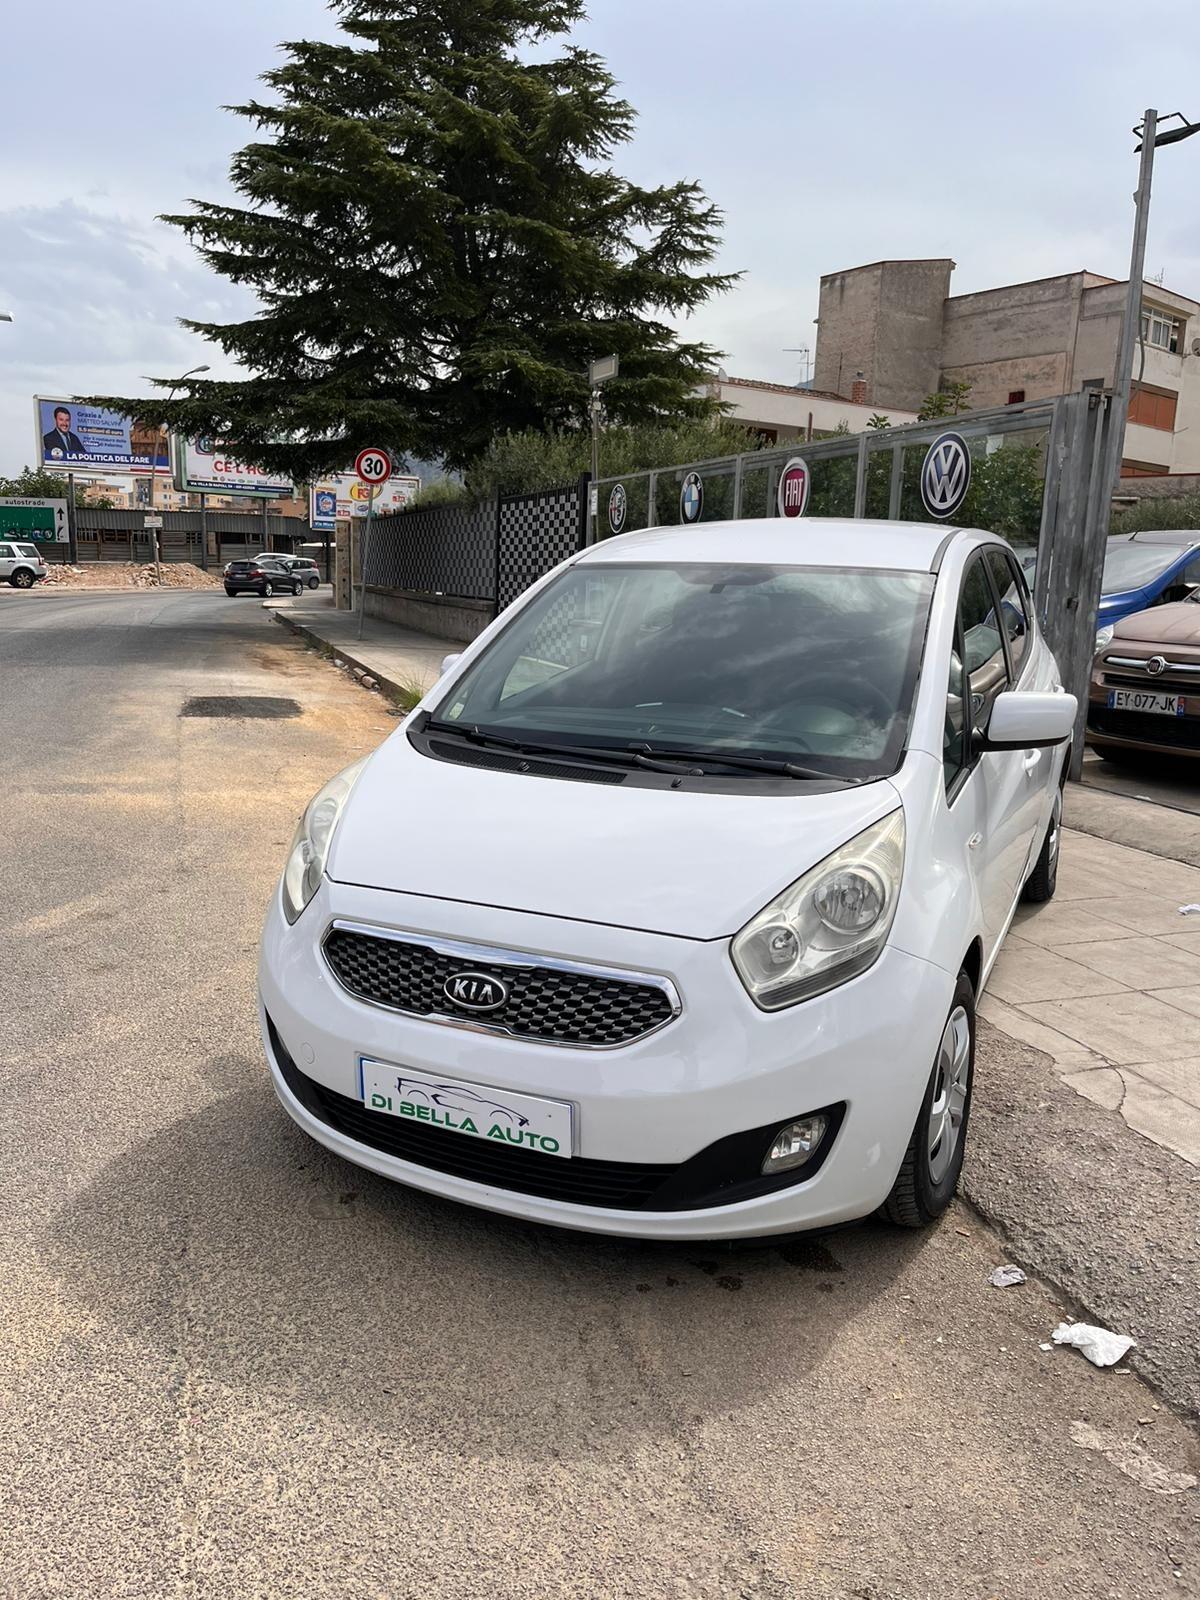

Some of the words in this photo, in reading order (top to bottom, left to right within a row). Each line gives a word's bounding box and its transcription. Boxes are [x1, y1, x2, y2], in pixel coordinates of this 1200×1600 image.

[78, 453, 114, 462] POLITICA
[115, 455, 130, 463] DEL
[130, 456, 150, 464] FARE
[364, 457, 384, 476] 30
[785, 478, 803, 506] FIAT
[1116, 692, 1175, 711] EY-077-JK
[452, 978, 494, 1004] KIA
[371, 1093, 392, 1111] DI
[400, 1100, 480, 1134] BELLA
[487, 1124, 560, 1153] AUTO
